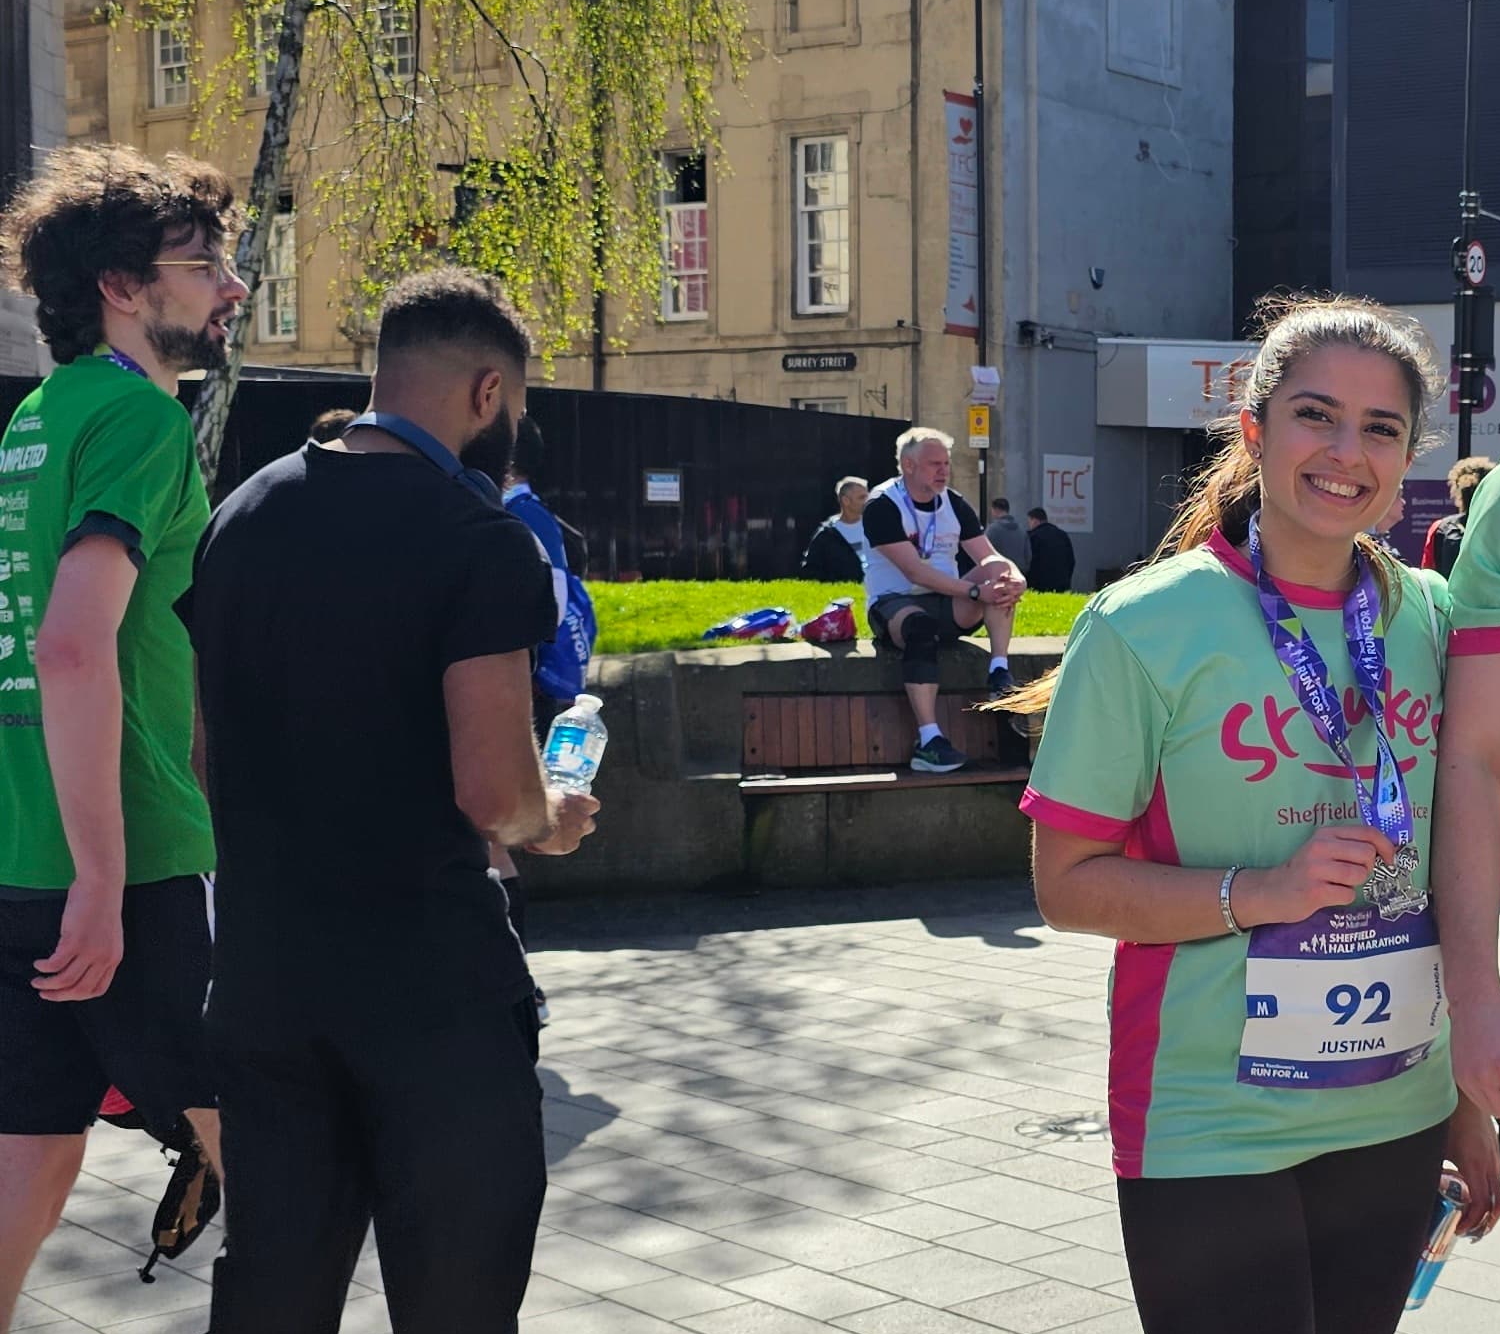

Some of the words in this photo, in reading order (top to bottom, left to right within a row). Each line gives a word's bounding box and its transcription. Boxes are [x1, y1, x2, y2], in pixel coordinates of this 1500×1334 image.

[1470, 255, 1484, 273] 20
[787, 357, 817, 368] SURREY
[820, 355, 847, 367] STREET
[1191, 360, 1256, 403] TF
[1046, 466, 1089, 500] TFC
[1356, 589, 1369, 608] ALL
[1360, 609, 1373, 630] FOR
[1363, 632, 1377, 655] RUN
[1296, 665, 1316, 692] RUN
[1308, 689, 1324, 714] FOR
[1320, 714, 1336, 735] ALL
[1221, 695, 1299, 782] St
[1277, 799, 1358, 826] Sheffield
[1328, 943, 1356, 954] HALF
[1357, 934, 1410, 952] MARATHON
[1329, 929, 1376, 943] SHEFFIELD
[1256, 1001, 1269, 1016] M
[1325, 981, 1392, 1026] 92
[1317, 1038, 1386, 1055] JUSTINA
[1250, 1067, 1271, 1077] RUN
[1272, 1069, 1292, 1079] FOR
[1292, 1070, 1310, 1080] ALL
